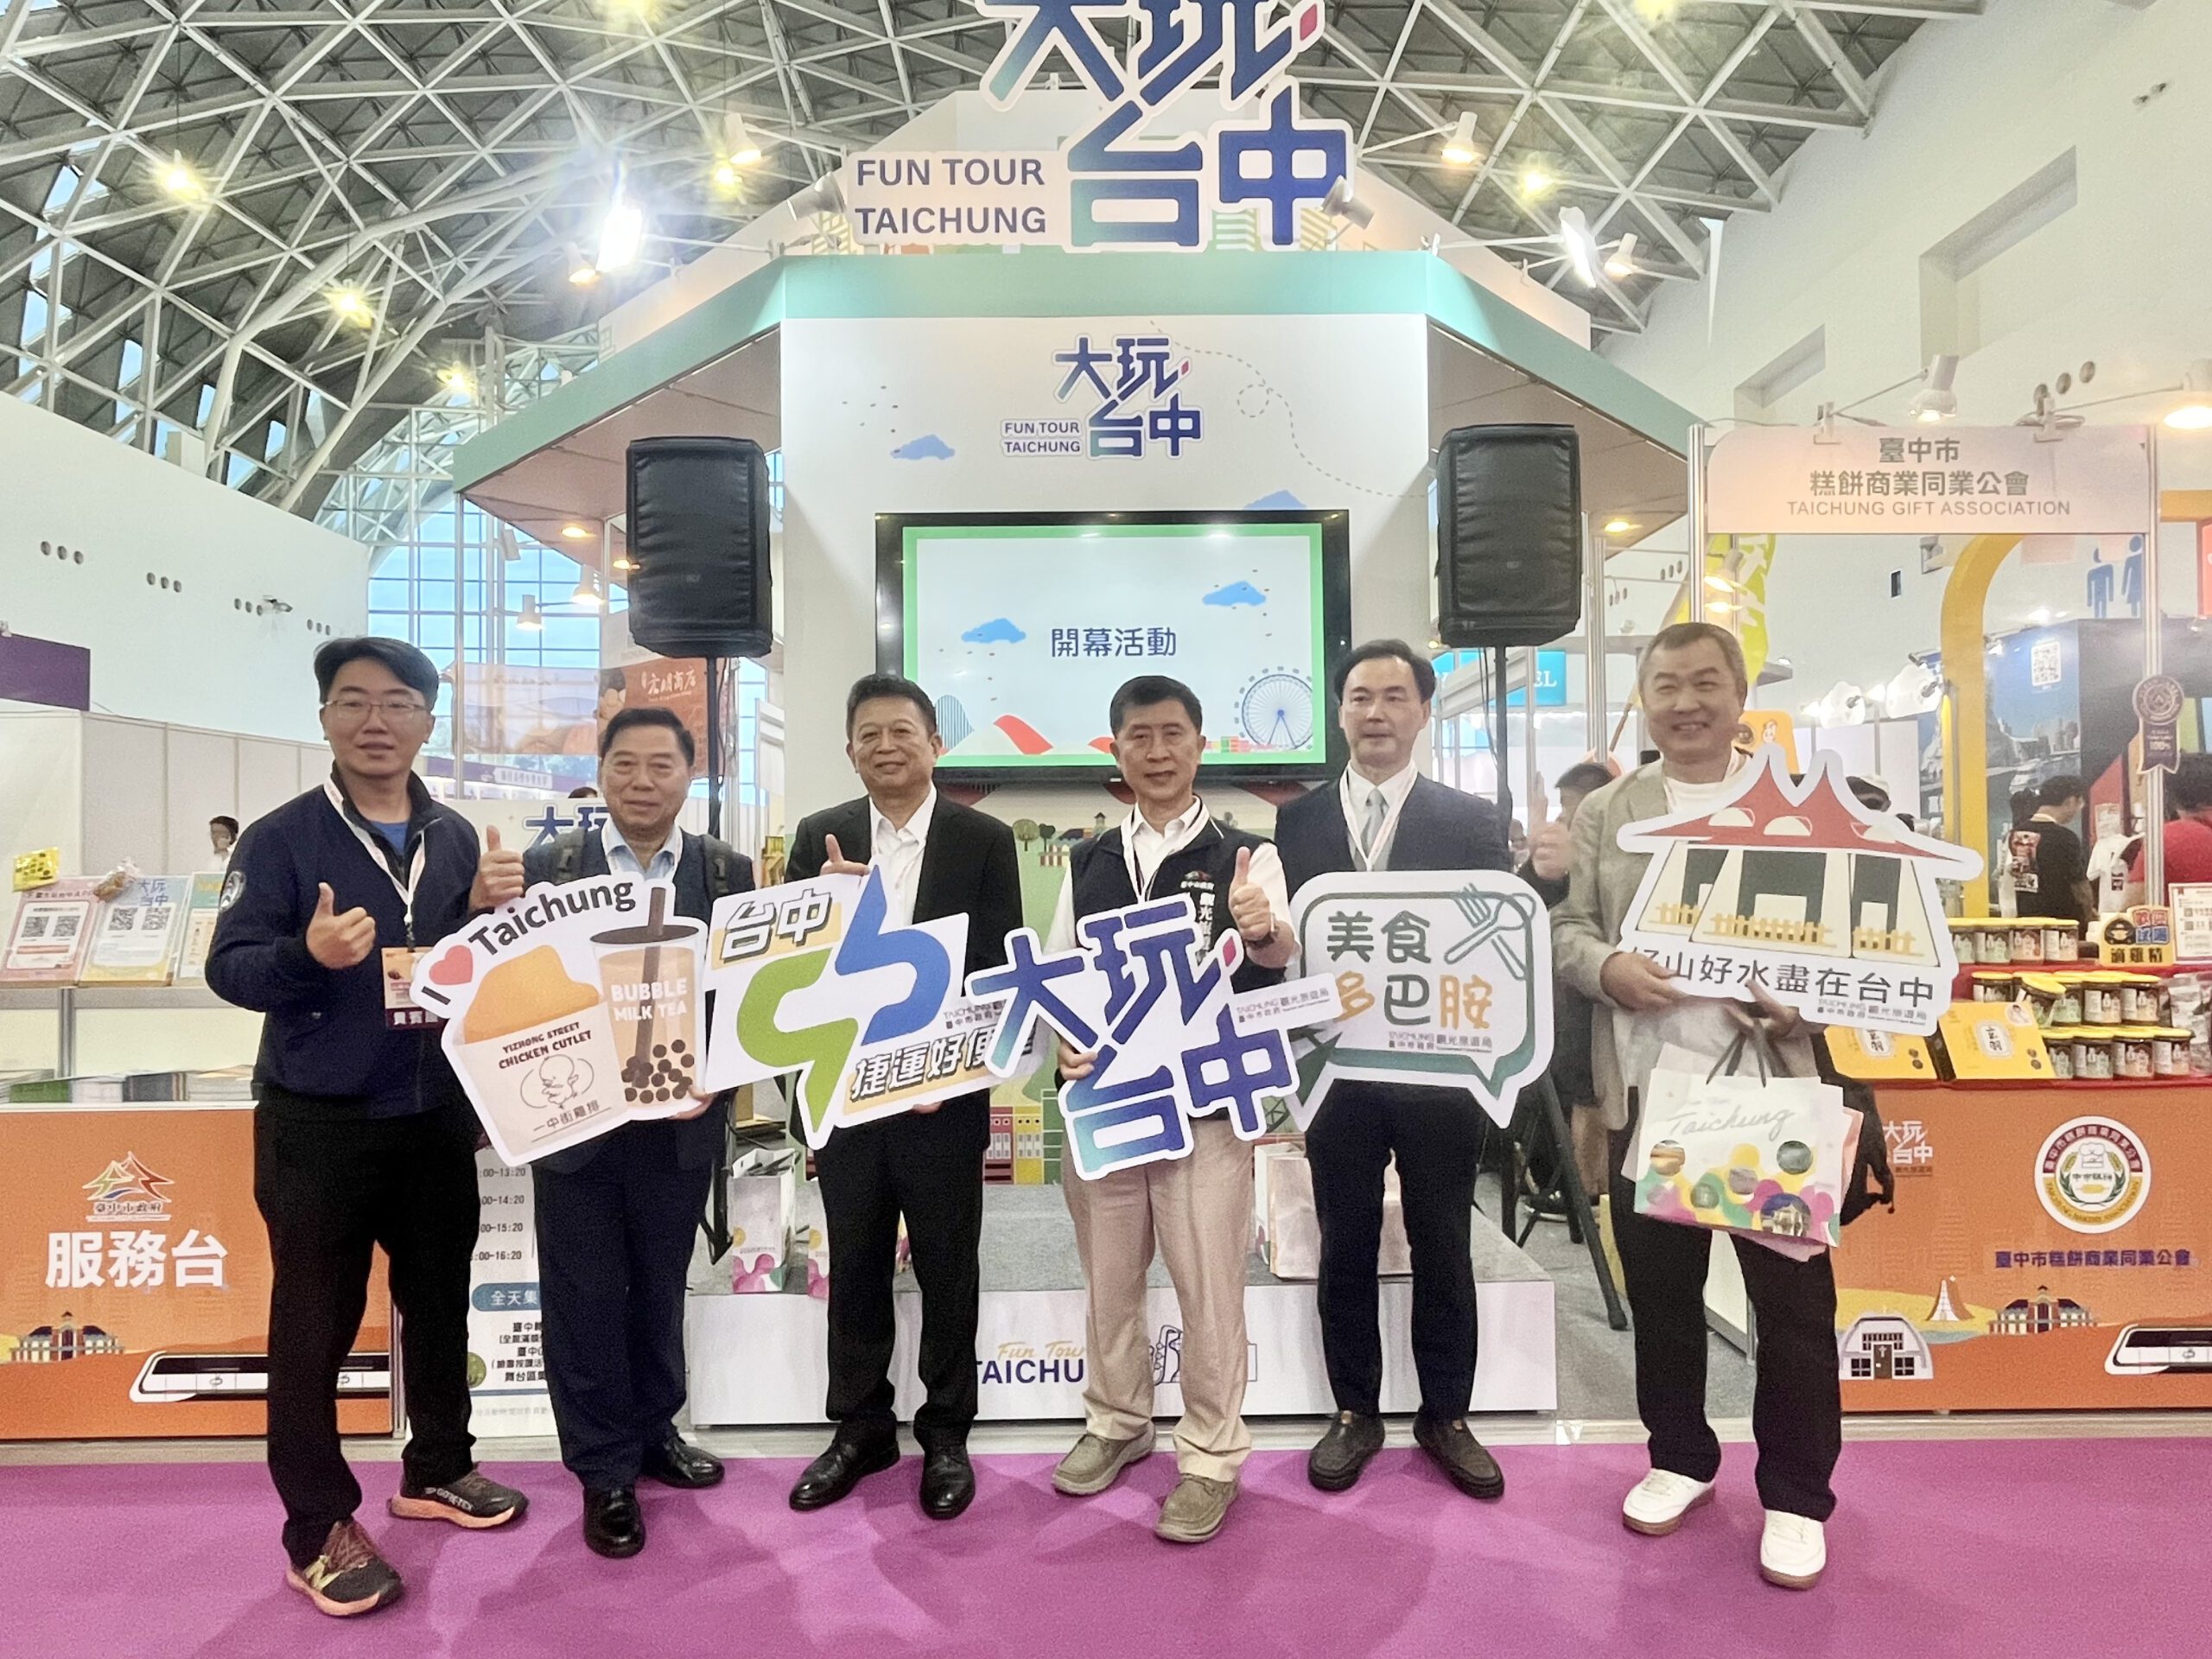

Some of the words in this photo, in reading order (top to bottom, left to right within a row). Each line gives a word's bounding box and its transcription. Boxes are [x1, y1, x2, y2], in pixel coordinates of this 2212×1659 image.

[856, 159, 930, 187] FUN
[942, 158, 1046, 187] TOUR
[1068, 91, 1346, 246] 台中
[855, 207, 1046, 234] TAICHUNG
[1055, 337, 1189, 401] 大玩
[1005, 423, 1034, 434] FUN
[1039, 422, 1079, 433] TOUR
[1089, 393, 1200, 456] 台中
[1005, 442, 1080, 453] TAICHUNG
[1878, 437, 1961, 463] 臺中市
[1810, 471, 2029, 496] 糕餅商業同業公會
[1788, 501, 1885, 515] TAICHUNG
[1892, 501, 1936, 515] GIFT
[1941, 501, 2070, 515] ASSOCIATION
[1050, 627, 1178, 658] 開幕活動
[1534, 671, 1557, 688] EL
[467, 882, 636, 956] Taichung
[721, 888, 832, 963] 台中
[1326, 910, 1432, 963] 美食
[611, 978, 688, 1001] BUBBLE
[971, 901, 1236, 1070] 大玩
[1335, 970, 1493, 1029] 多巴胺
[613, 1005, 652, 1021] MILK
[658, 1001, 687, 1018] TEA
[547, 1021, 580, 1039] STREET
[499, 1045, 549, 1069] CHICKEN
[552, 1030, 591, 1051] CUTLET
[850, 1023, 1036, 1102] 捷運好便
[1066, 1003, 1293, 1173] 台中
[1667, 1105, 1796, 1141] Taichung
[1882, 1121, 1929, 1143] 大玩
[1892, 1141, 1933, 1164] 台中
[46, 1229, 228, 1289] 服務台
[491, 1290, 538, 1306] 全天集
[998, 1341, 1035, 1361] Fun
[976, 1358, 1084, 1384] AICHU
